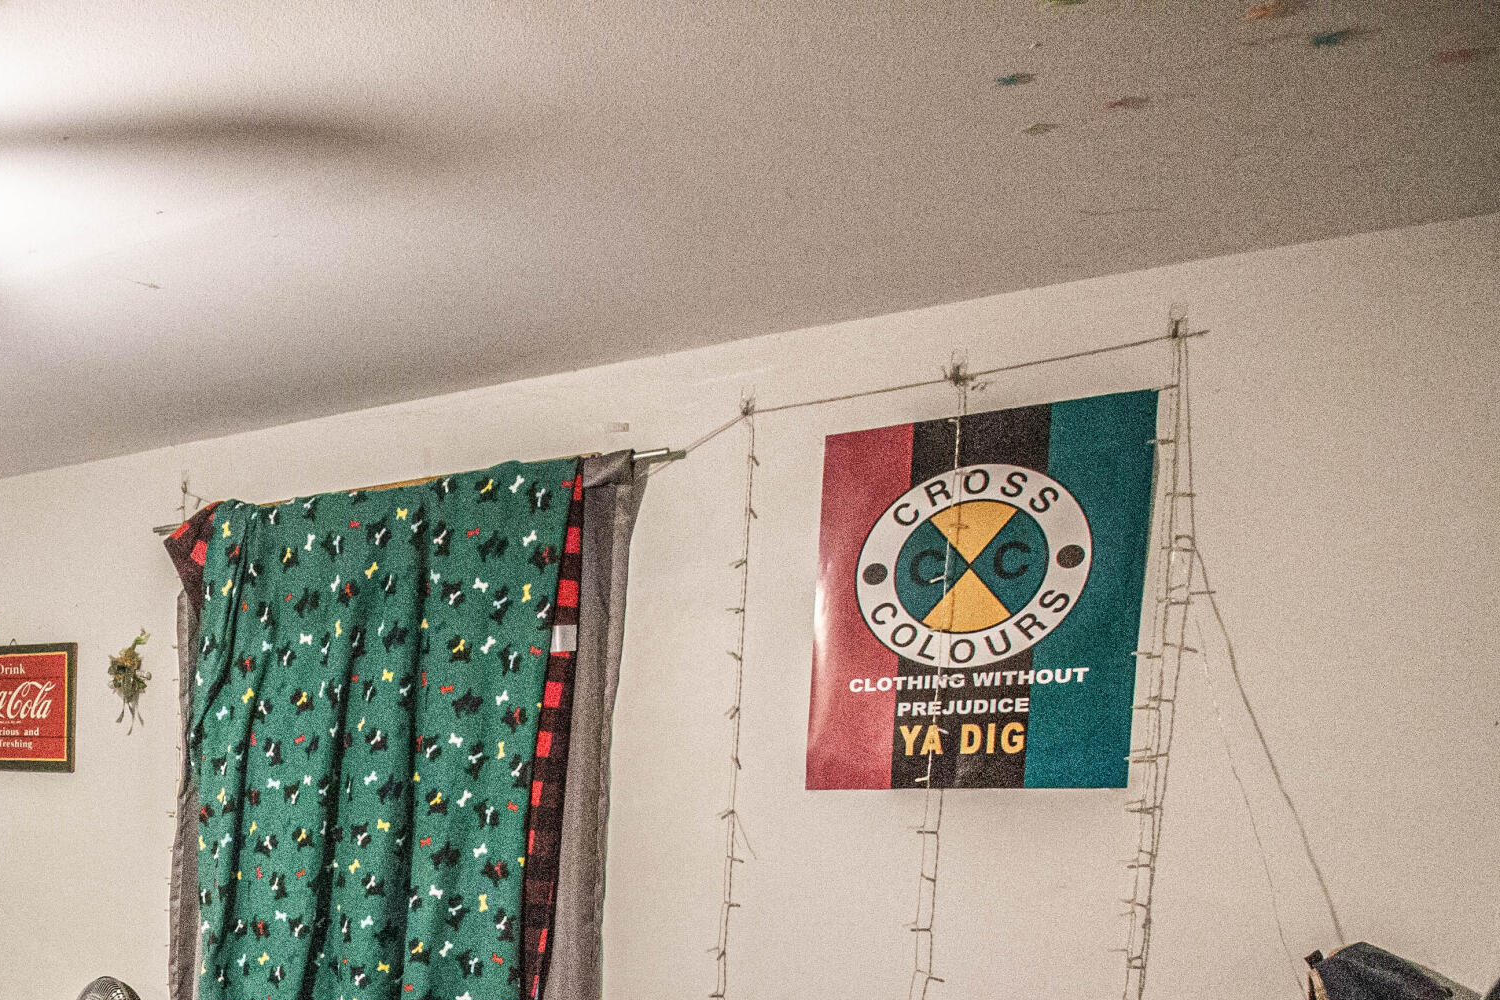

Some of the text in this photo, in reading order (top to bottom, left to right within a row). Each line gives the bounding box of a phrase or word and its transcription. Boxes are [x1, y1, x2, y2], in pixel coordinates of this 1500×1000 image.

[893, 468, 1059, 527] CROSS
[910, 541, 1031, 586] C C
[870, 588, 1069, 664] COLOURS
[849, 667, 1090, 694] CLOTHING WITHOUT
[897, 697, 1030, 718] PREJUDICE
[23, 727, 40, 737] and
[899, 722, 1025, 757] YA DIG
